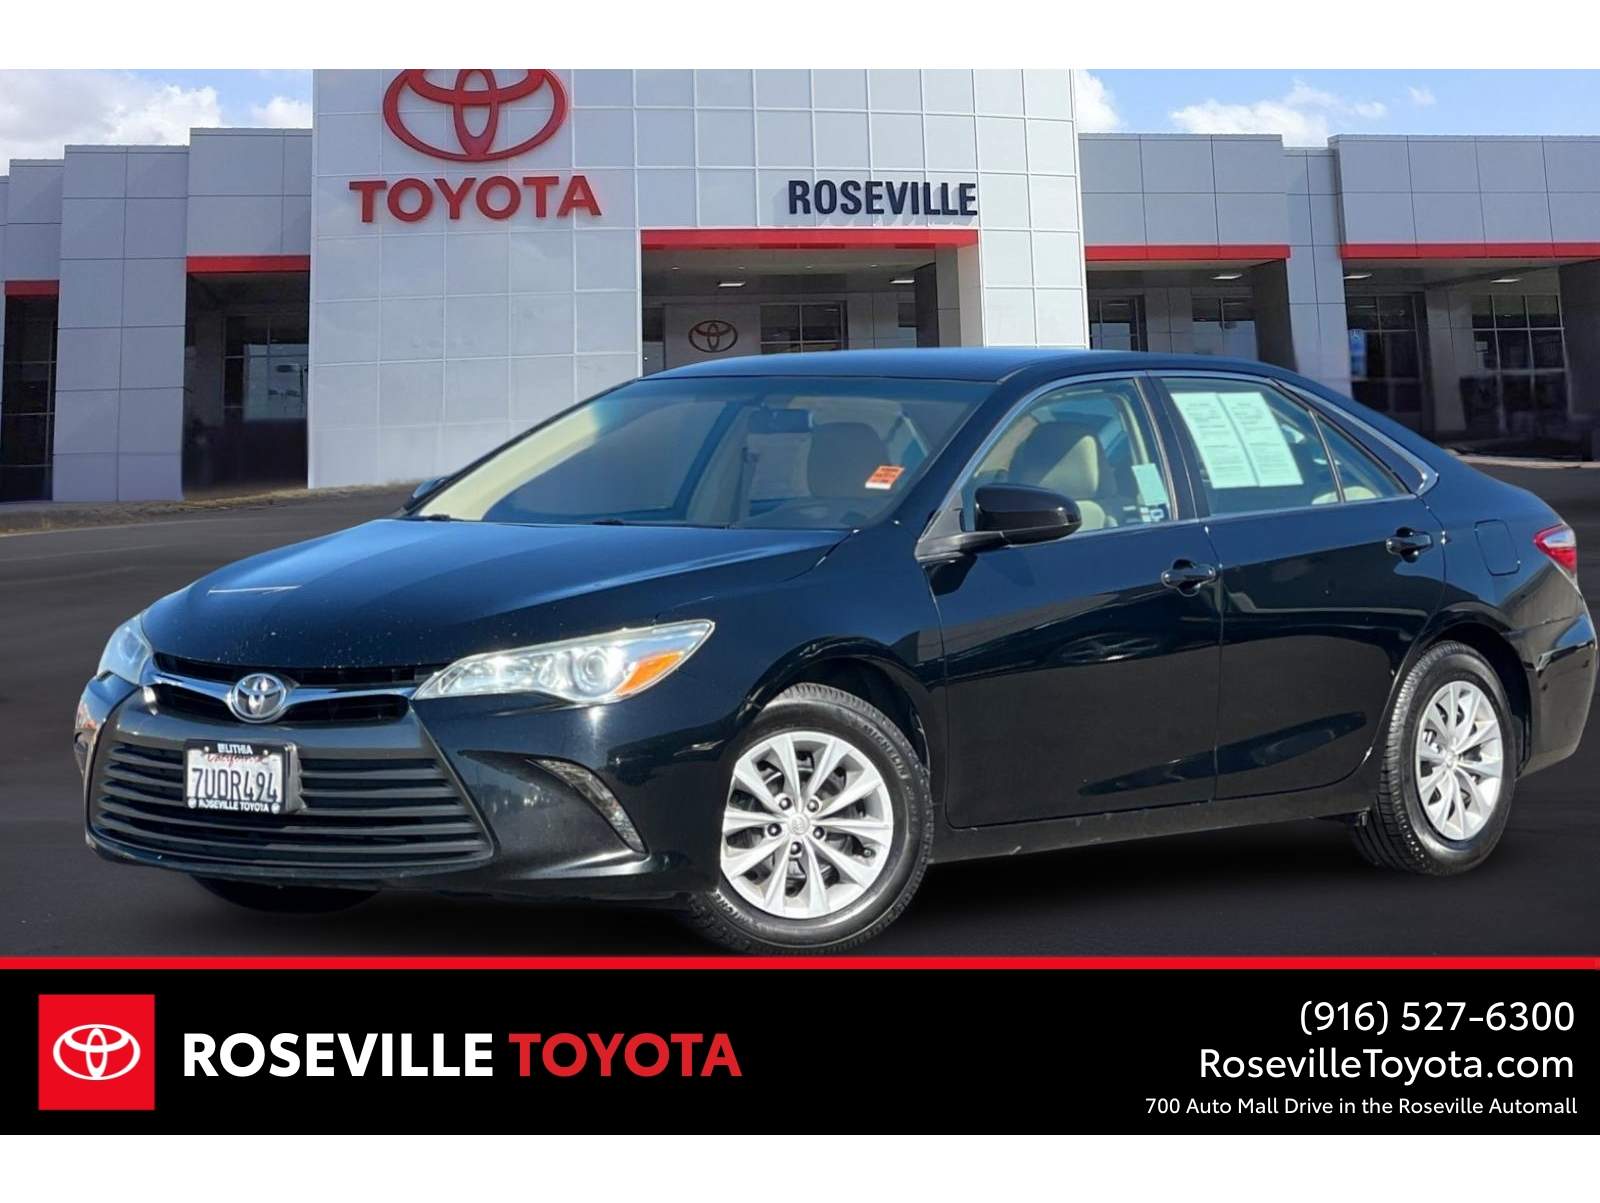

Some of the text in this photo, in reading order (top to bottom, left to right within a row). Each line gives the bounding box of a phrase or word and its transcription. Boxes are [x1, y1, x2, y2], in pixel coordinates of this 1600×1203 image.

[349, 174, 603, 224] TOYOTA
[788, 179, 979, 217] ROSEVILLE
[198, 799, 269, 812] ROSEVILLE TOYOTA
